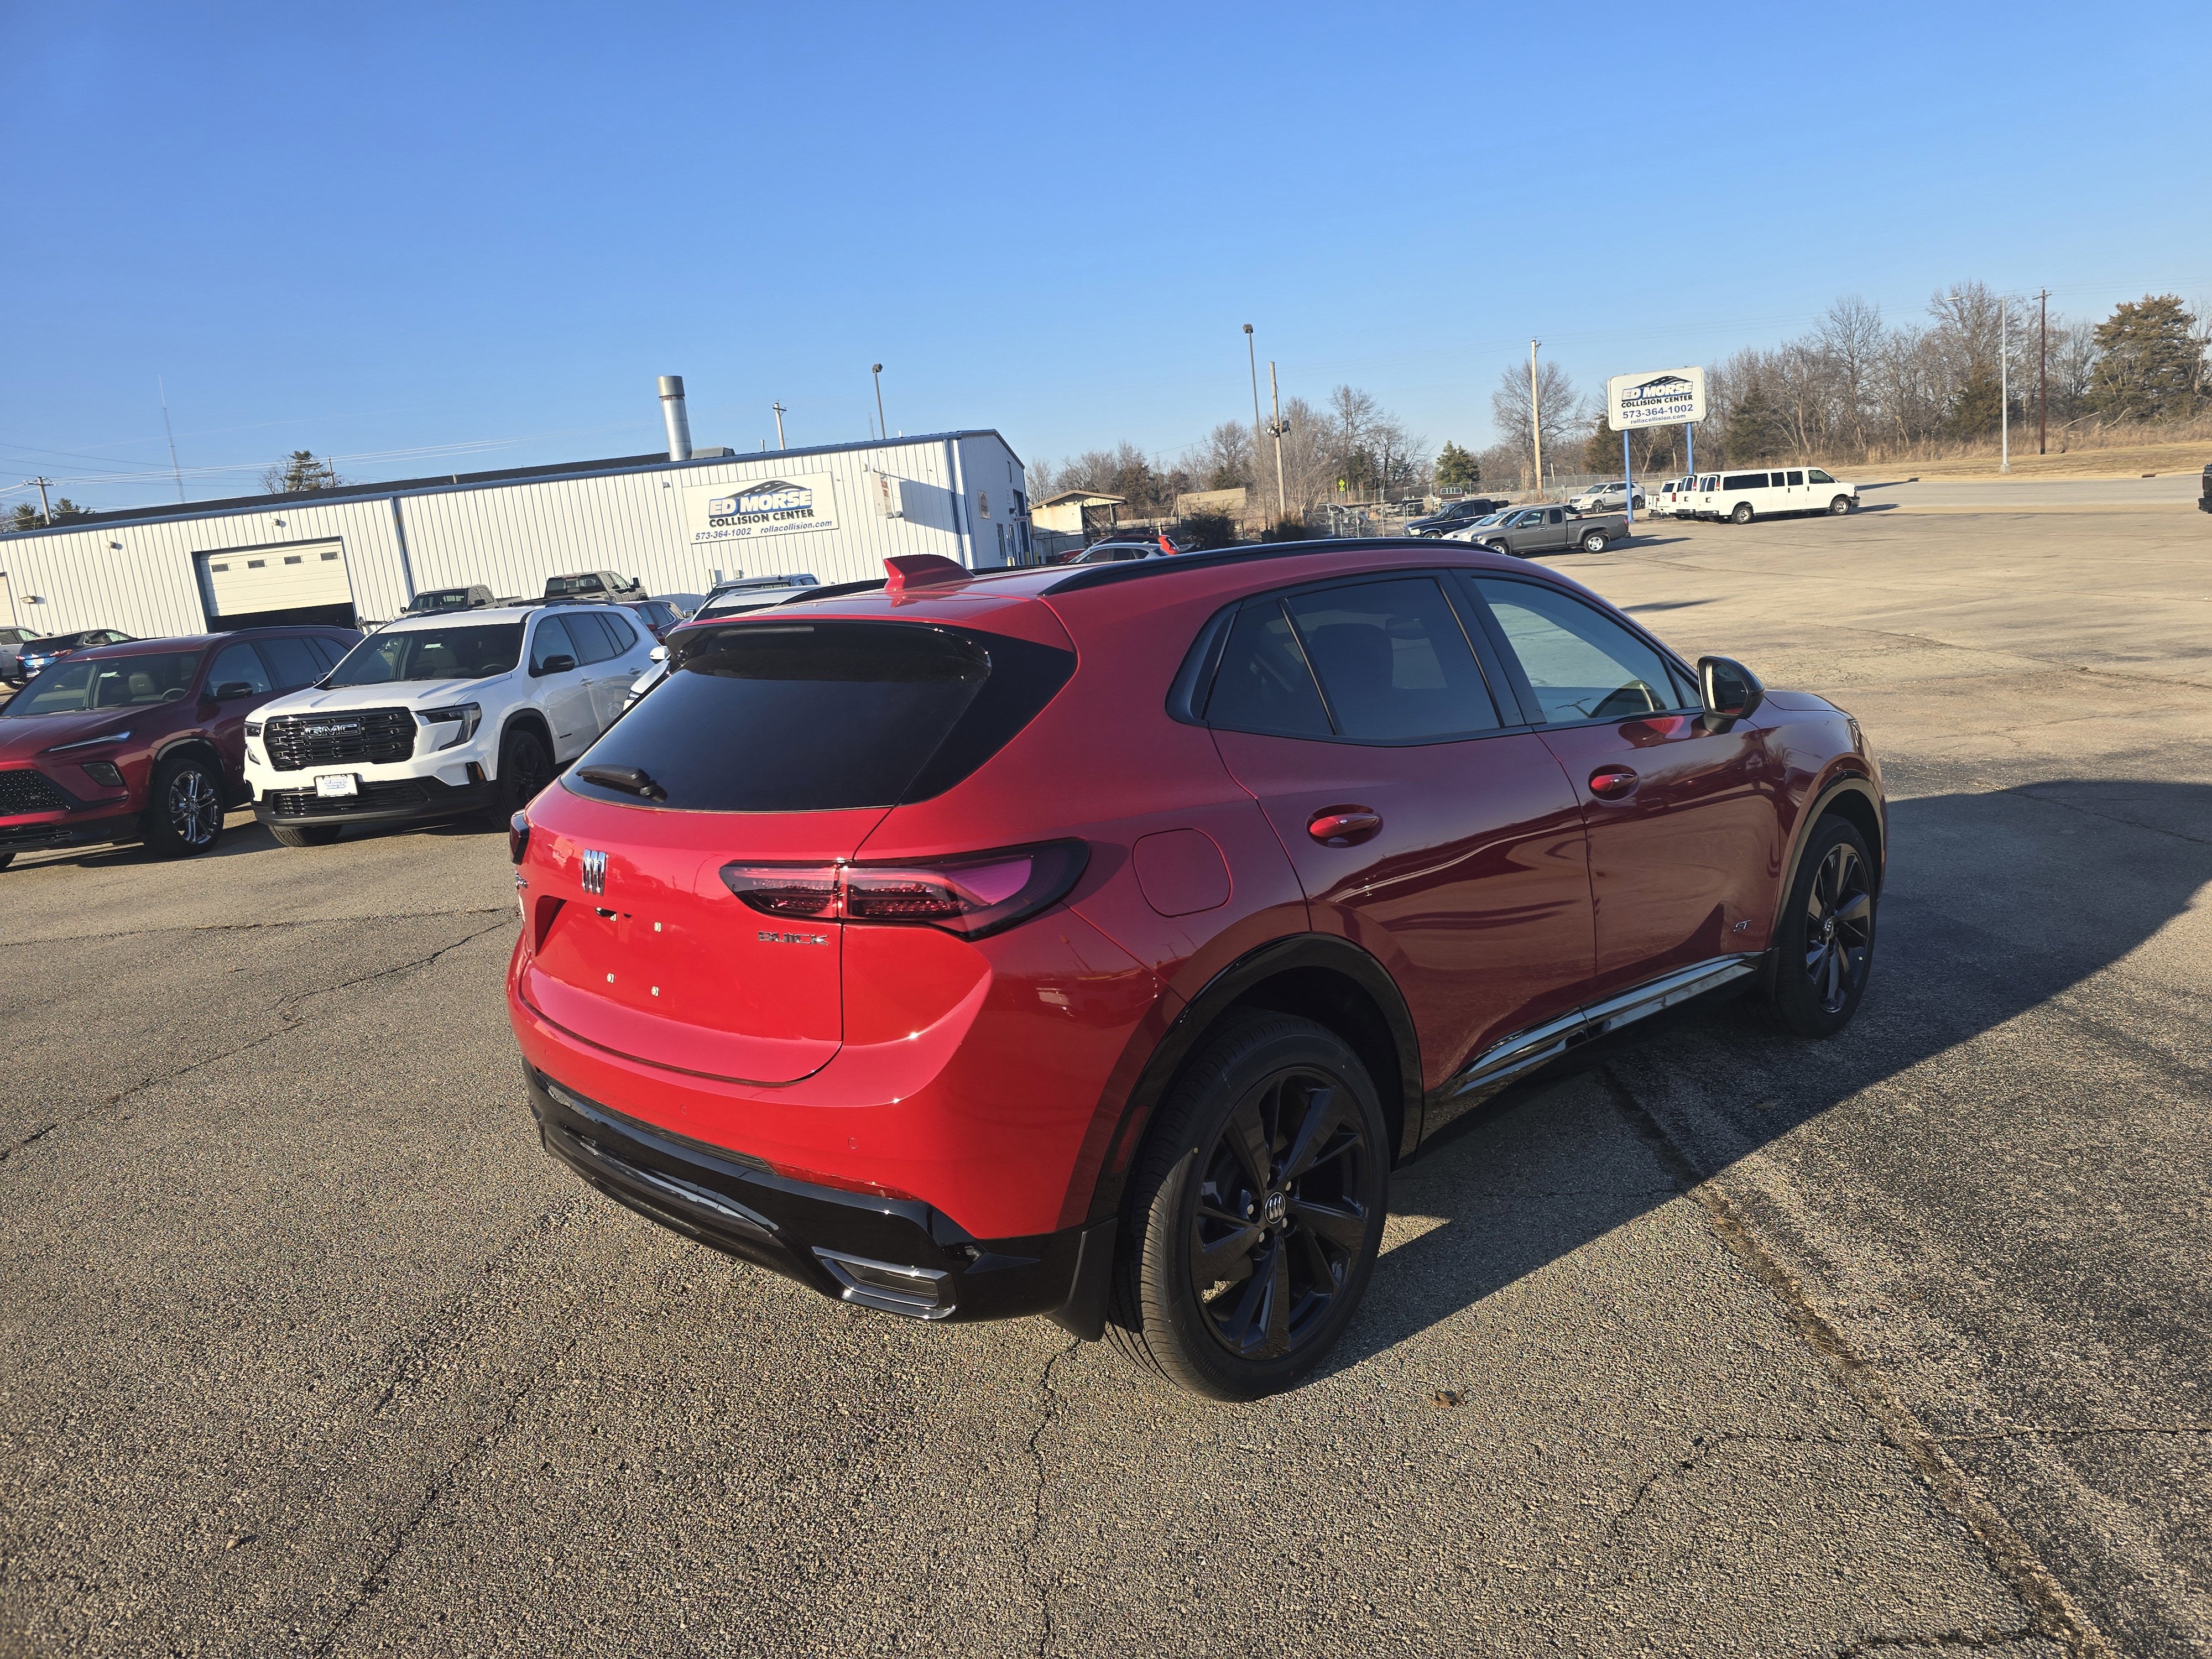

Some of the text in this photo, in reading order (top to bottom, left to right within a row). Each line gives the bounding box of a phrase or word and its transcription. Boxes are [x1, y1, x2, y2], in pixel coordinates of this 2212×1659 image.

[1621, 382, 1693, 401] ED MORSE
[1621, 395, 1693, 408] COLLISION CENTER
[1623, 404, 1693, 419] 573-364-1002
[1631, 414, 1686, 424] rollacollision.com
[709, 489, 812, 518] ED MORSE
[709, 509, 815, 527] COLLISION CENTER
[695, 520, 832, 540] 573-364-1002 rollacollision.com
[305, 724, 358, 737] GMC
[758, 931, 830, 946] BUICK
